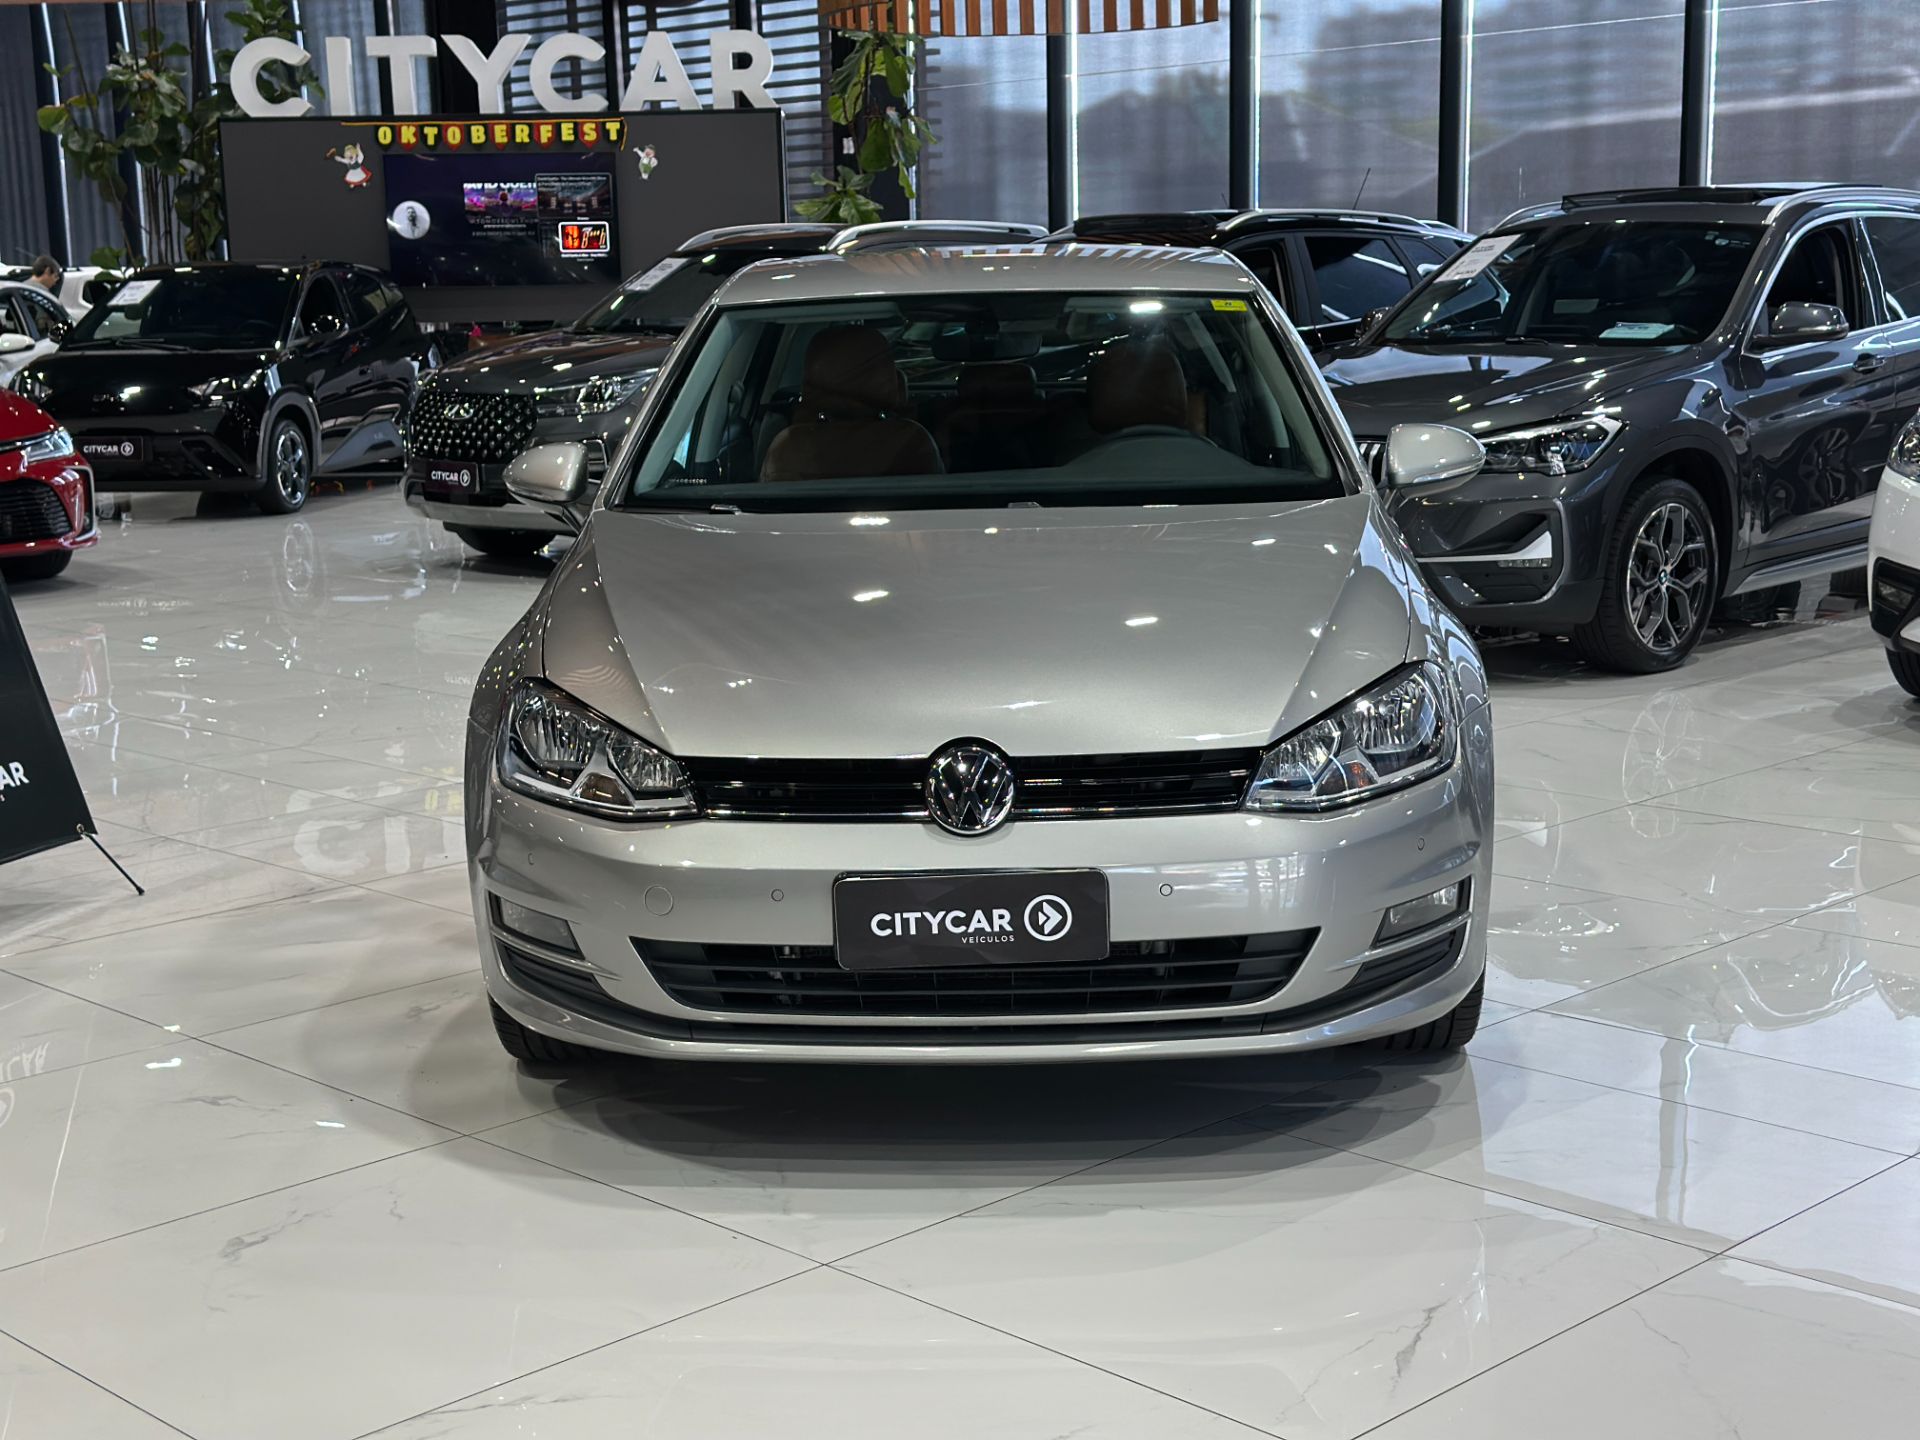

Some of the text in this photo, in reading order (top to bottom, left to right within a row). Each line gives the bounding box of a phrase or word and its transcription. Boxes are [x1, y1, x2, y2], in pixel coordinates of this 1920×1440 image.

[230, 31, 778, 116] CITYCAR
[377, 122, 621, 146] OKTOBERFEST
[83, 444, 119, 453] CITYCAR
[431, 470, 459, 482] CITYCAR
[870, 909, 1013, 937] CITYCAR
[961, 935, 1015, 944] VEÍCULOS
